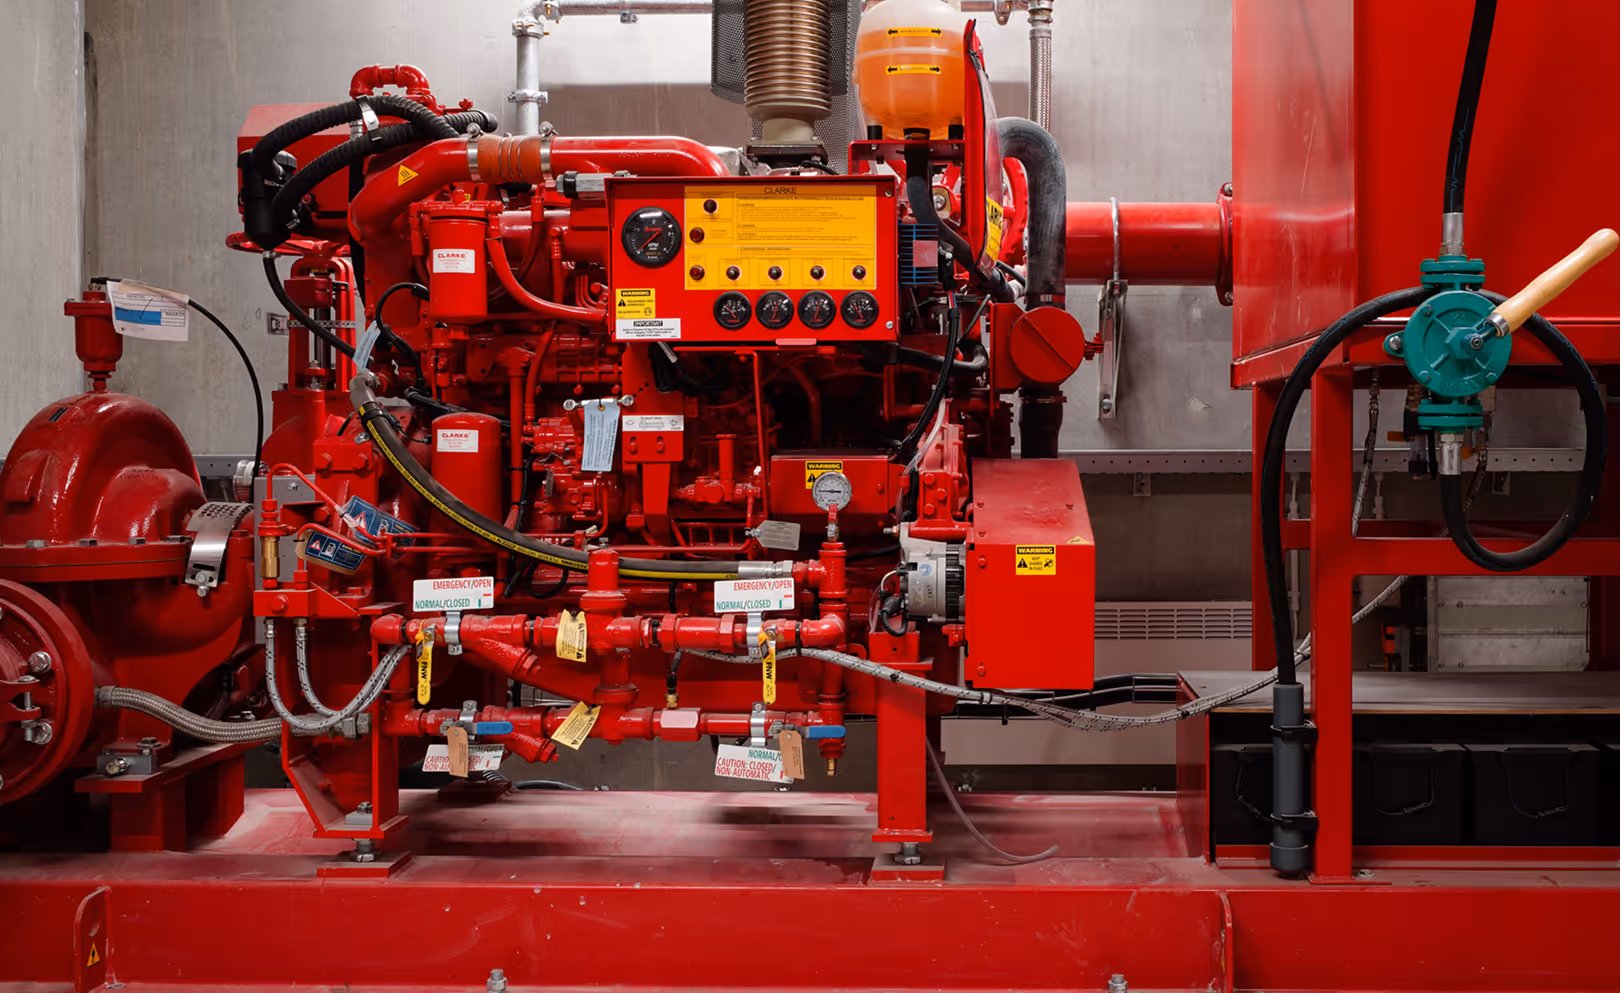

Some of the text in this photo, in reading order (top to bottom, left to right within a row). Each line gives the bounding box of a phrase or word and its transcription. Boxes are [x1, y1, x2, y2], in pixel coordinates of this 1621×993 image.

[764, 186, 797, 194] CLARKE
[433, 579, 491, 590] EMERGENCY/OPEN
[734, 580, 792, 591] EMERGENCY/OPEN
[415, 599, 470, 609] NORMAL/CLOSED
[716, 600, 771, 610] NORMAL/CLOSED
[765, 661, 773, 680] FNW
[425, 755, 449, 764] CAUTIO
[717, 757, 776, 774] CAUTION: CLOSED/
[716, 767, 771, 780] NON-AUTOMATIC
